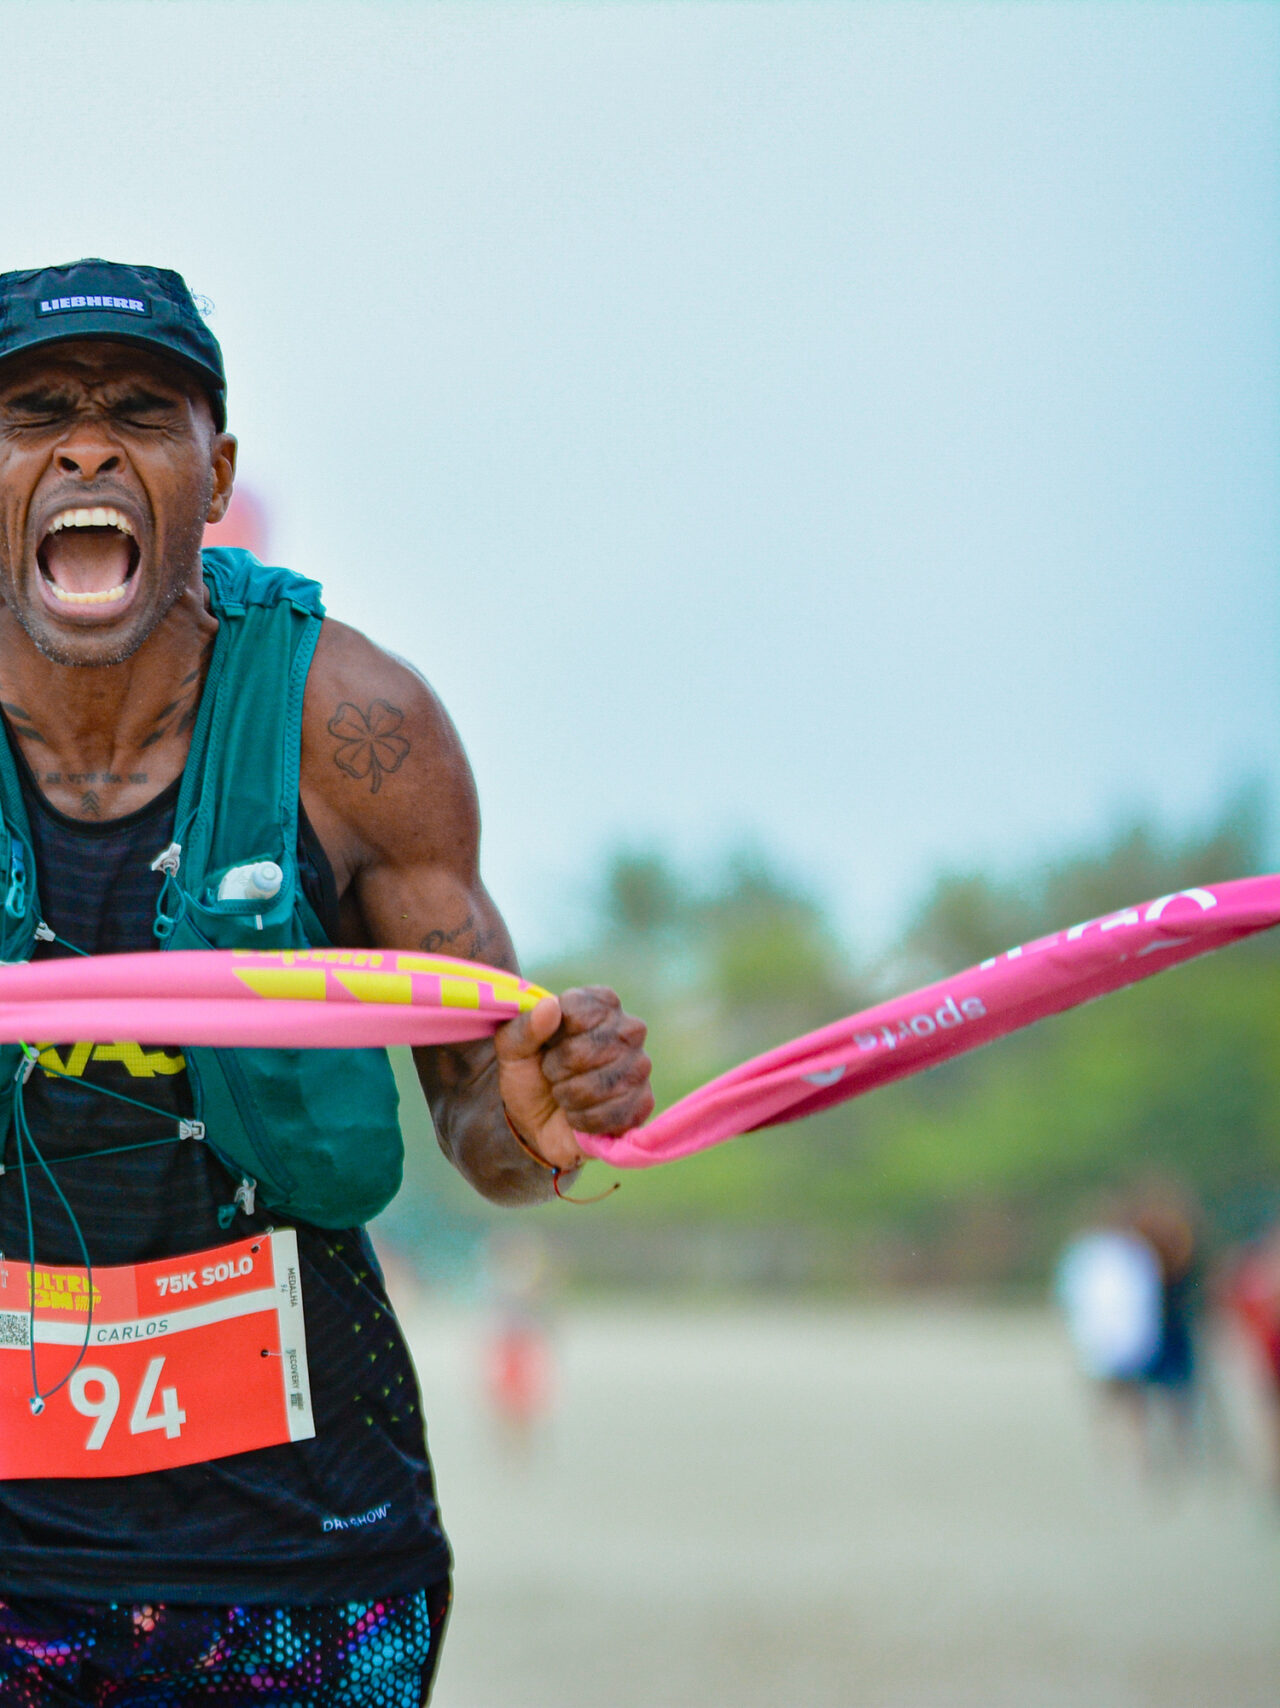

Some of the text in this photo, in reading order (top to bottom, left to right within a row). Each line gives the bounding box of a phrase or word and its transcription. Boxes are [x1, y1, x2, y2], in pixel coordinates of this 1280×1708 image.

[40, 296, 145, 312] LIEBHERR
[156, 1257, 254, 1296] 75K SOLO
[287, 1267, 299, 1308] MEDALHA
[96, 1319, 170, 1344] CARLOS
[69, 1356, 187, 1450] 94
